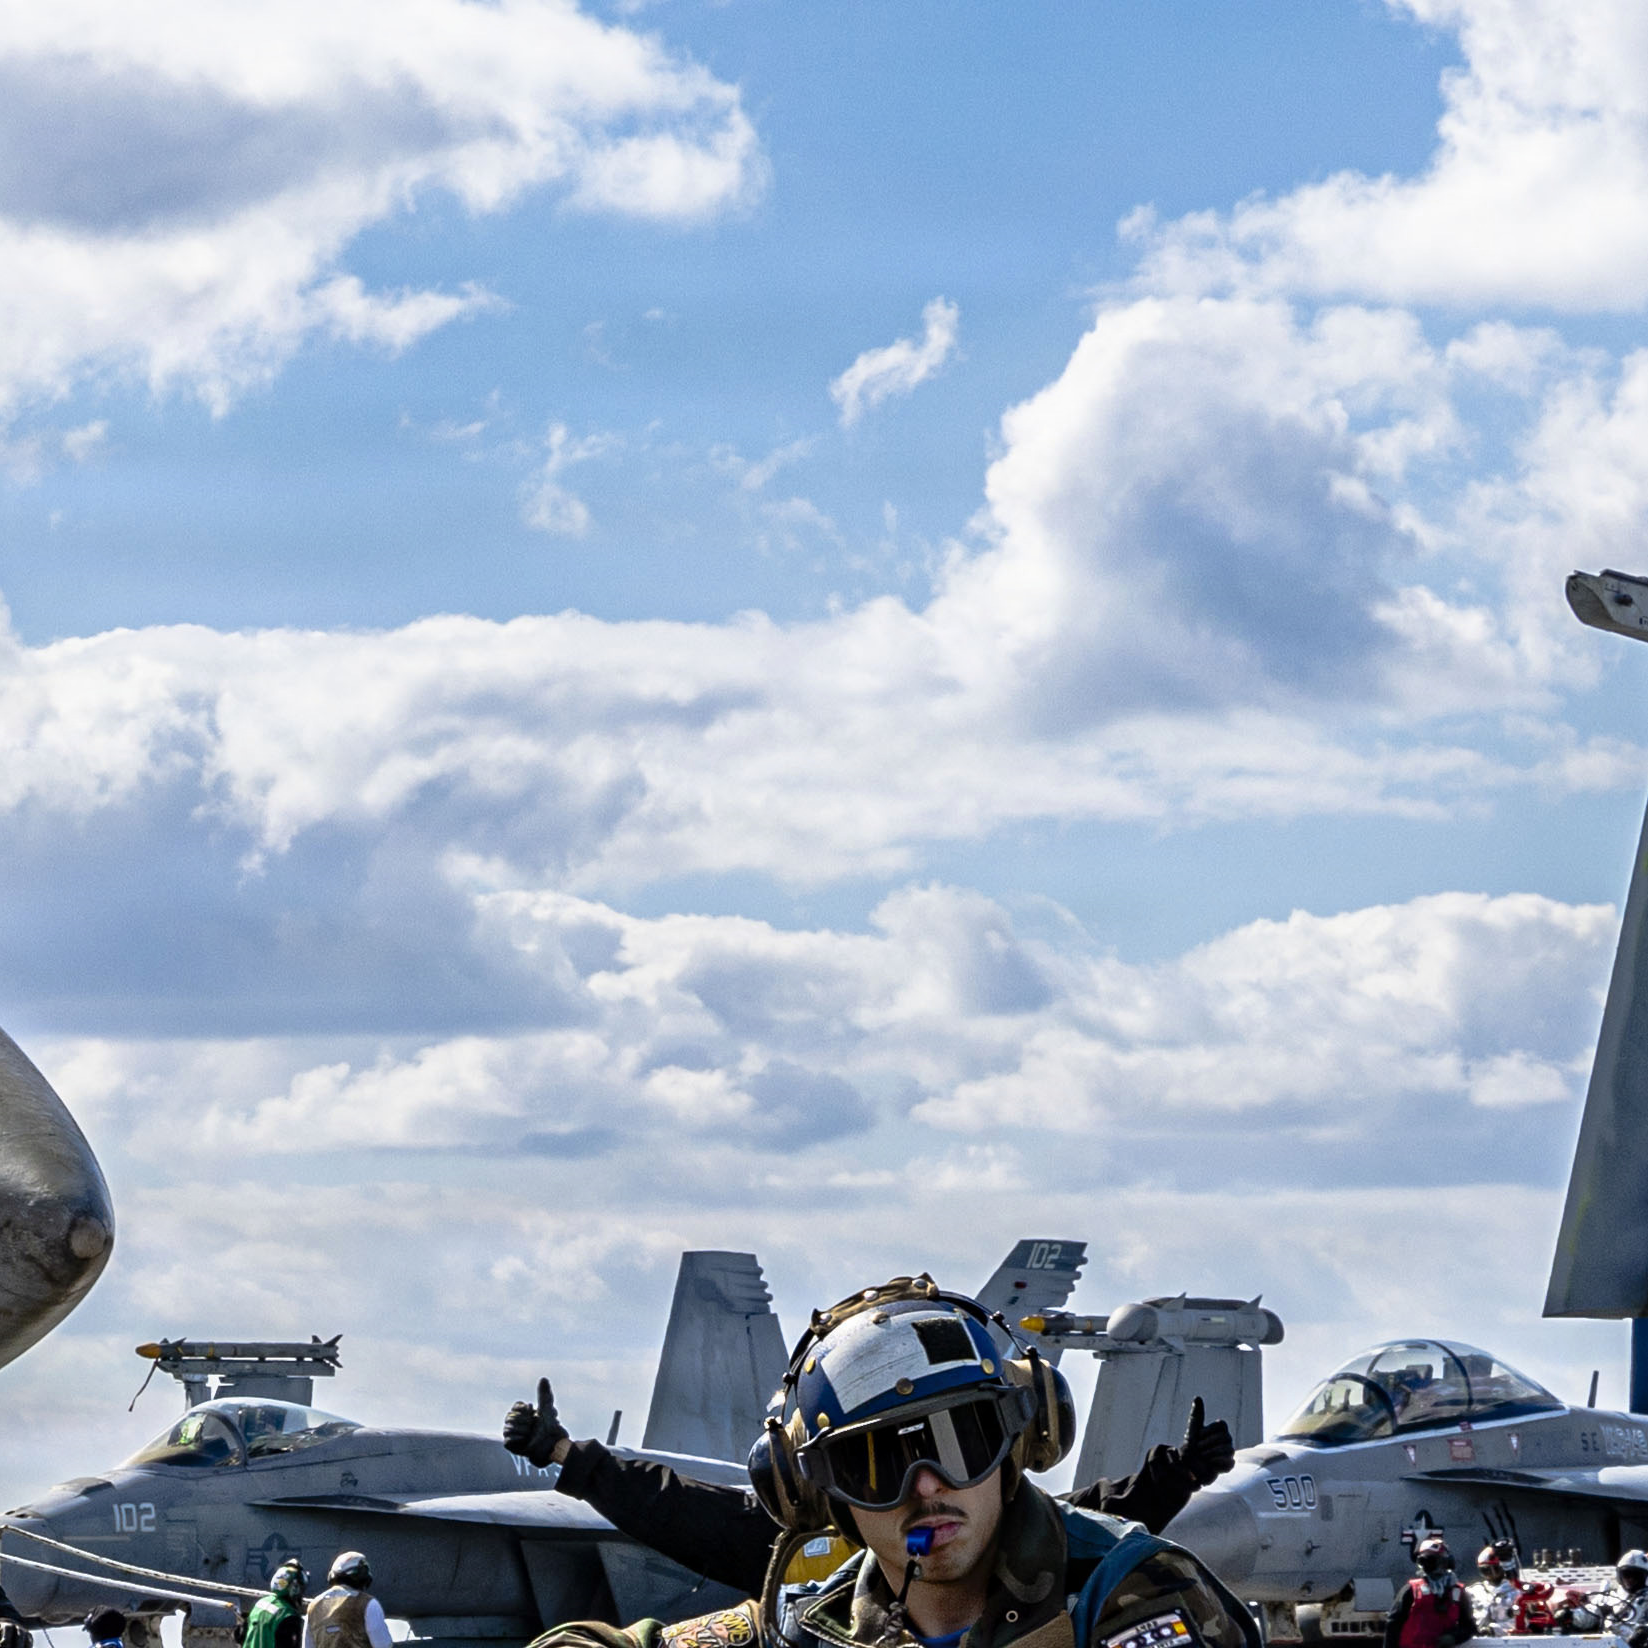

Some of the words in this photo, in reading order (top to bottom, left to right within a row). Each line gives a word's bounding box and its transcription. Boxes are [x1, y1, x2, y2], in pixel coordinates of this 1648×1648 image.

[1026, 1242, 1062, 1269] 102
[1264, 1474, 1317, 1510] 500
[112, 1503, 156, 1533] 102
